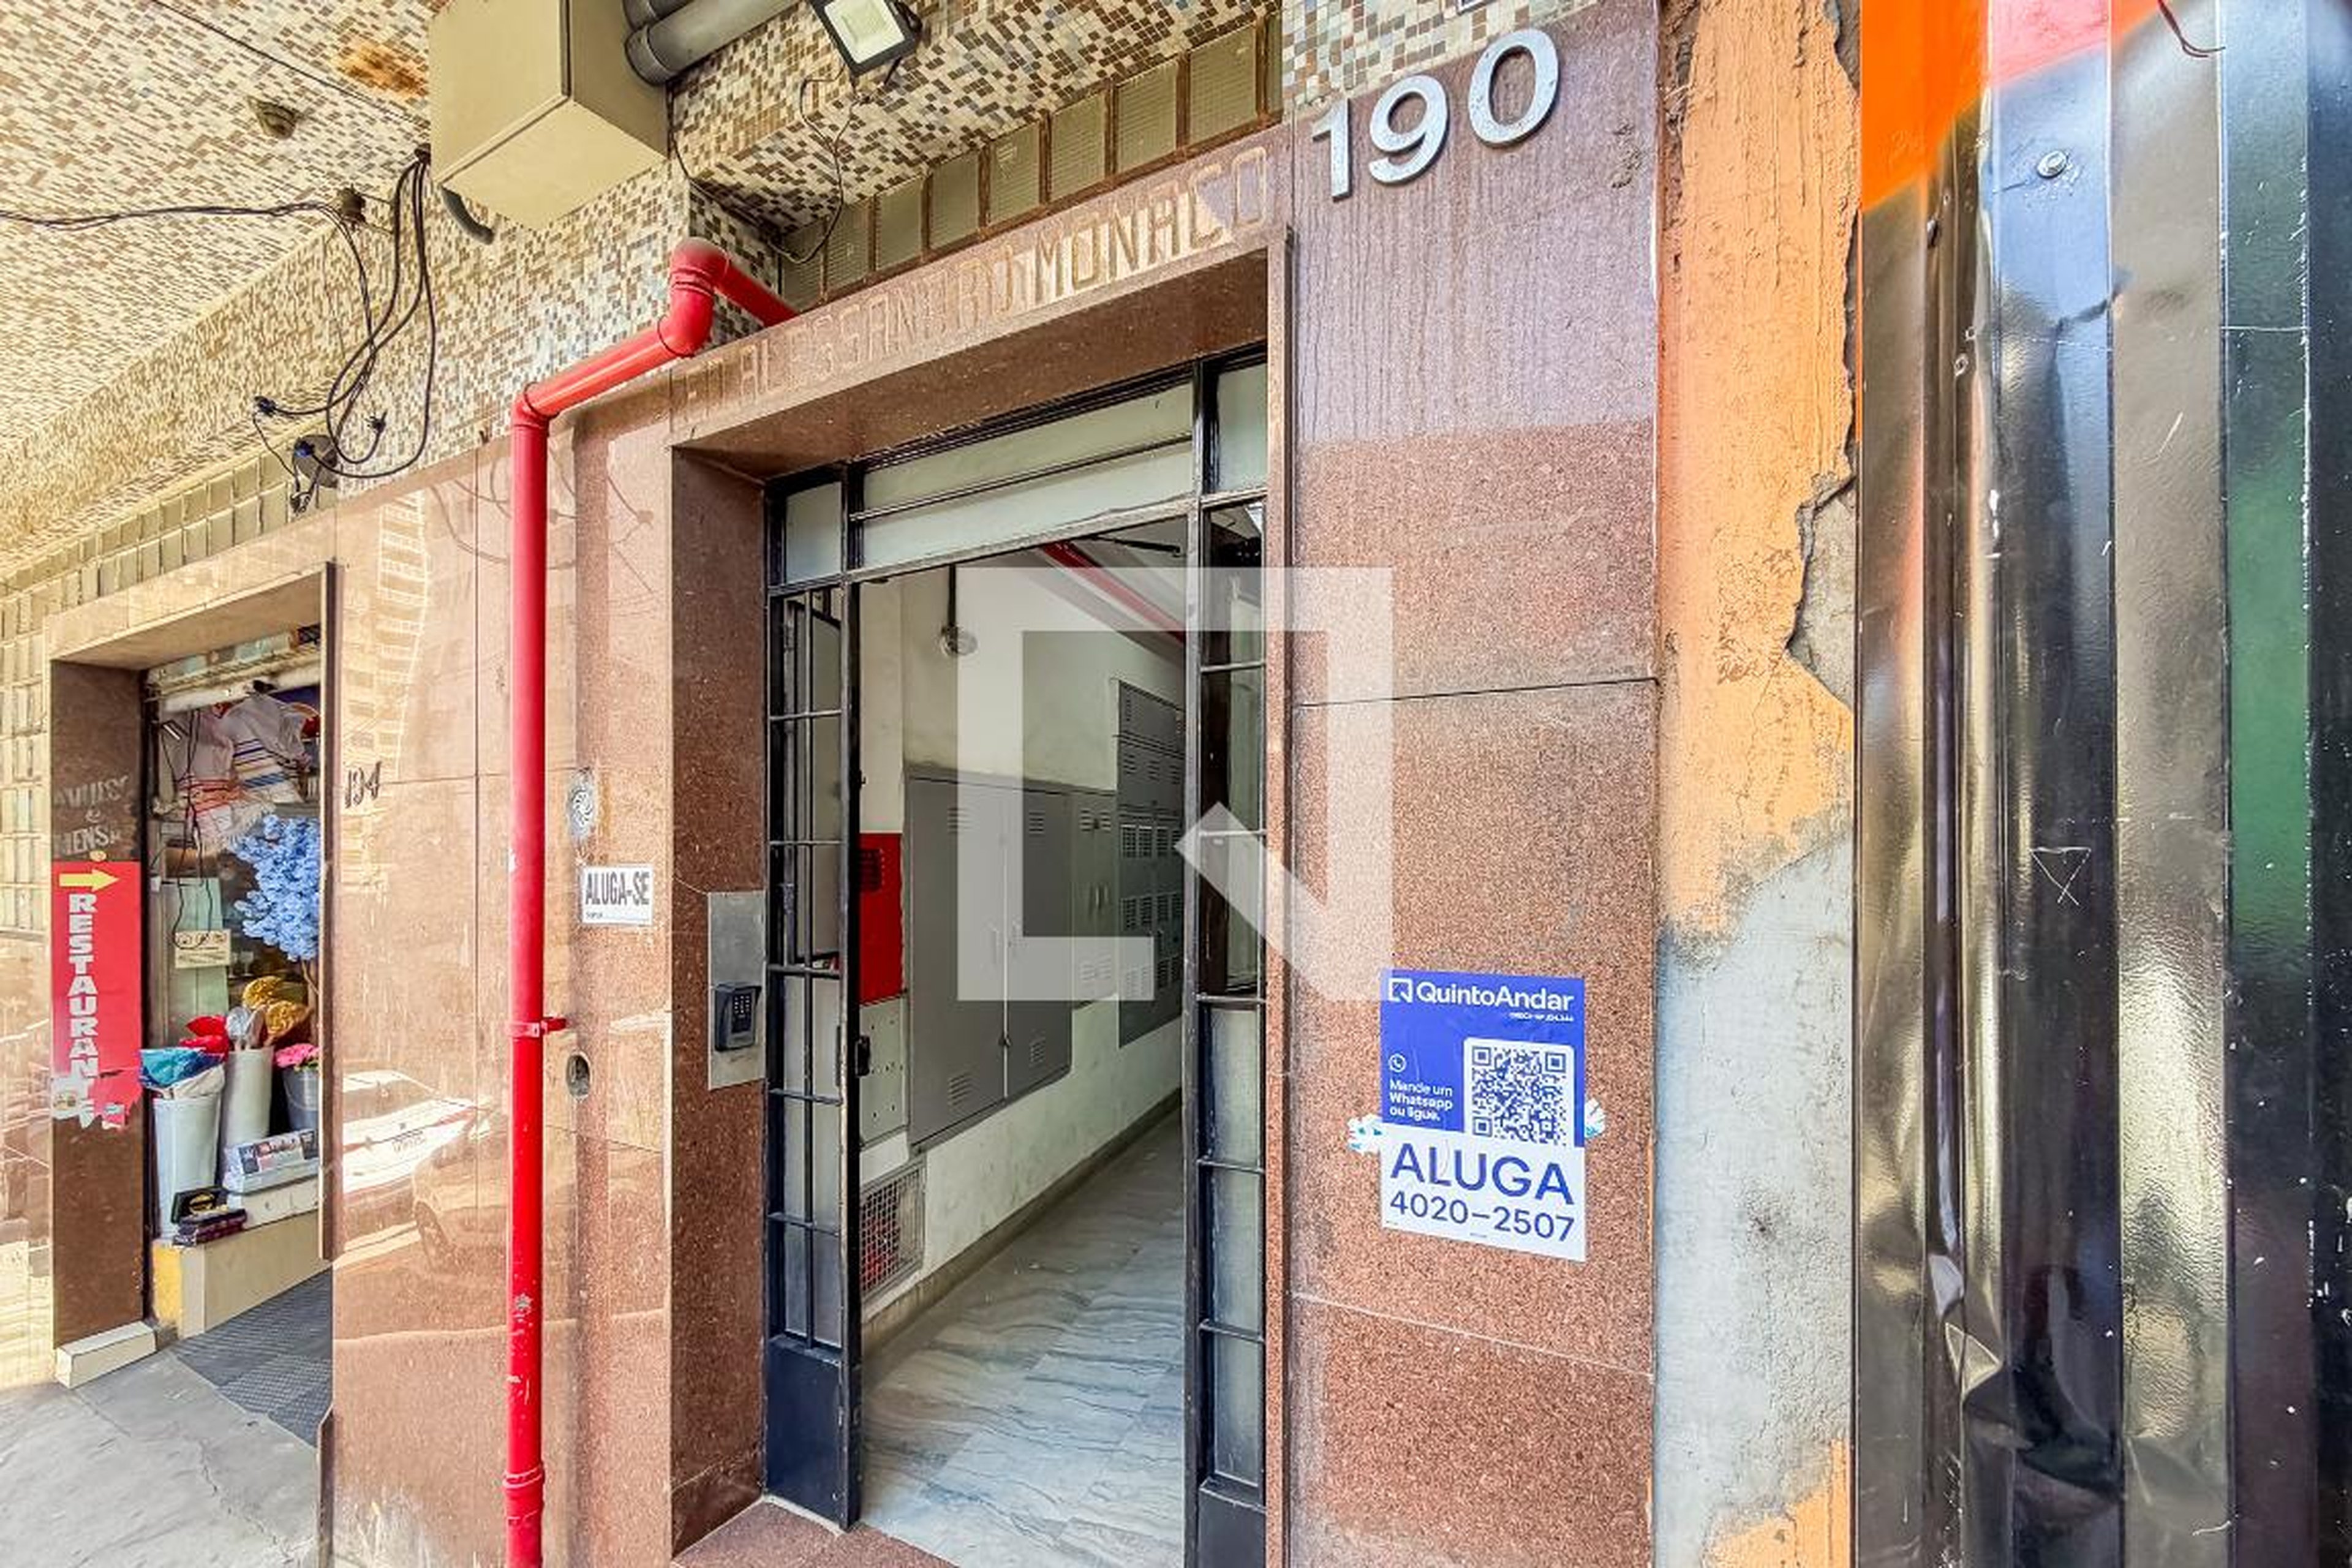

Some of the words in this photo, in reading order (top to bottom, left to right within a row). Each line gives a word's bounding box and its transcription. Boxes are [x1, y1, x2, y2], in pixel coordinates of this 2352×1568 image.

[1312, 28, 1562, 202] 190
[1033, 146, 1267, 304] MONACO
[585, 871, 650, 906] ALUGA-SE
[1416, 981, 1574, 1011] QuintoAndar
[1389, 1079, 1431, 1095] Mande
[1433, 1085, 1453, 1097] um
[1389, 1091, 1453, 1111] Whatsapp
[1389, 1106, 1406, 1117] ou
[1390, 1144, 1575, 1205] ALUGA
[1389, 1191, 1575, 1242] 4020-2507
